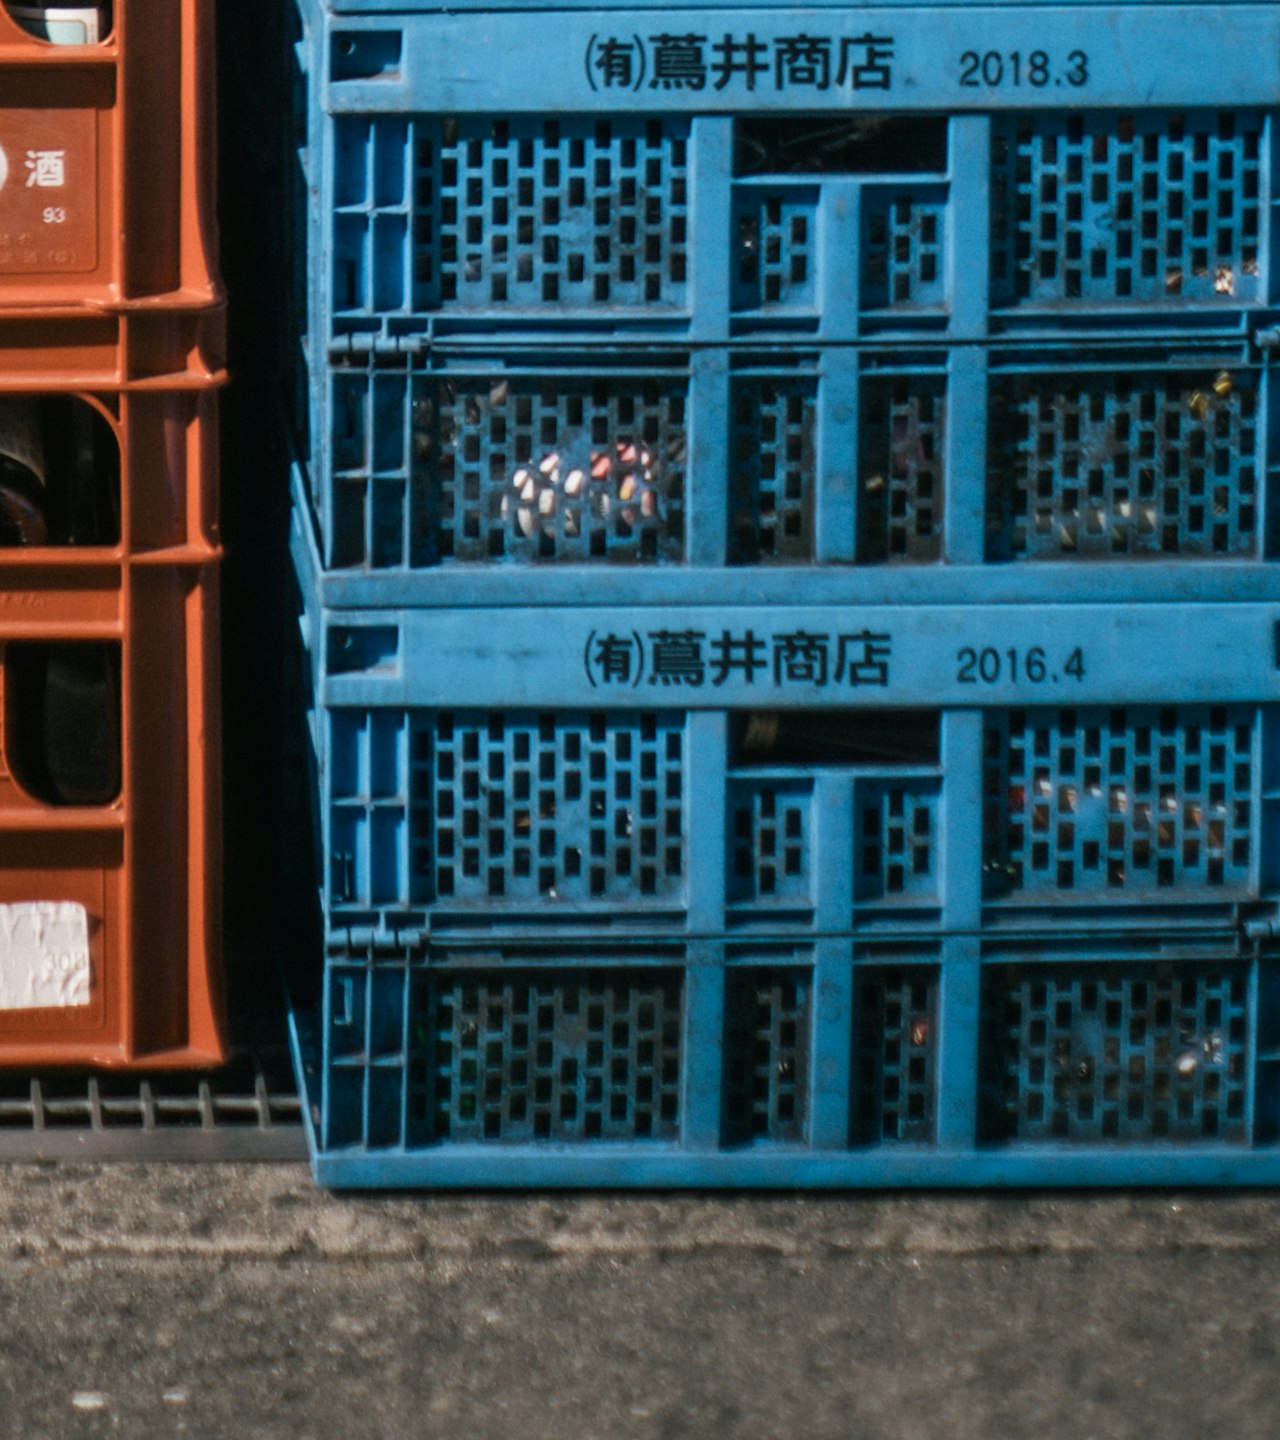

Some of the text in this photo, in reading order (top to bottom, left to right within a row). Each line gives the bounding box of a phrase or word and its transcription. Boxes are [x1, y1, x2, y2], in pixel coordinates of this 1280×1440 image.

[958, 50, 1089, 88] 2018.3
[24, 150, 65, 188] 酒
[42, 207, 66, 223] 93
[957, 646, 1086, 683] 2016.4
